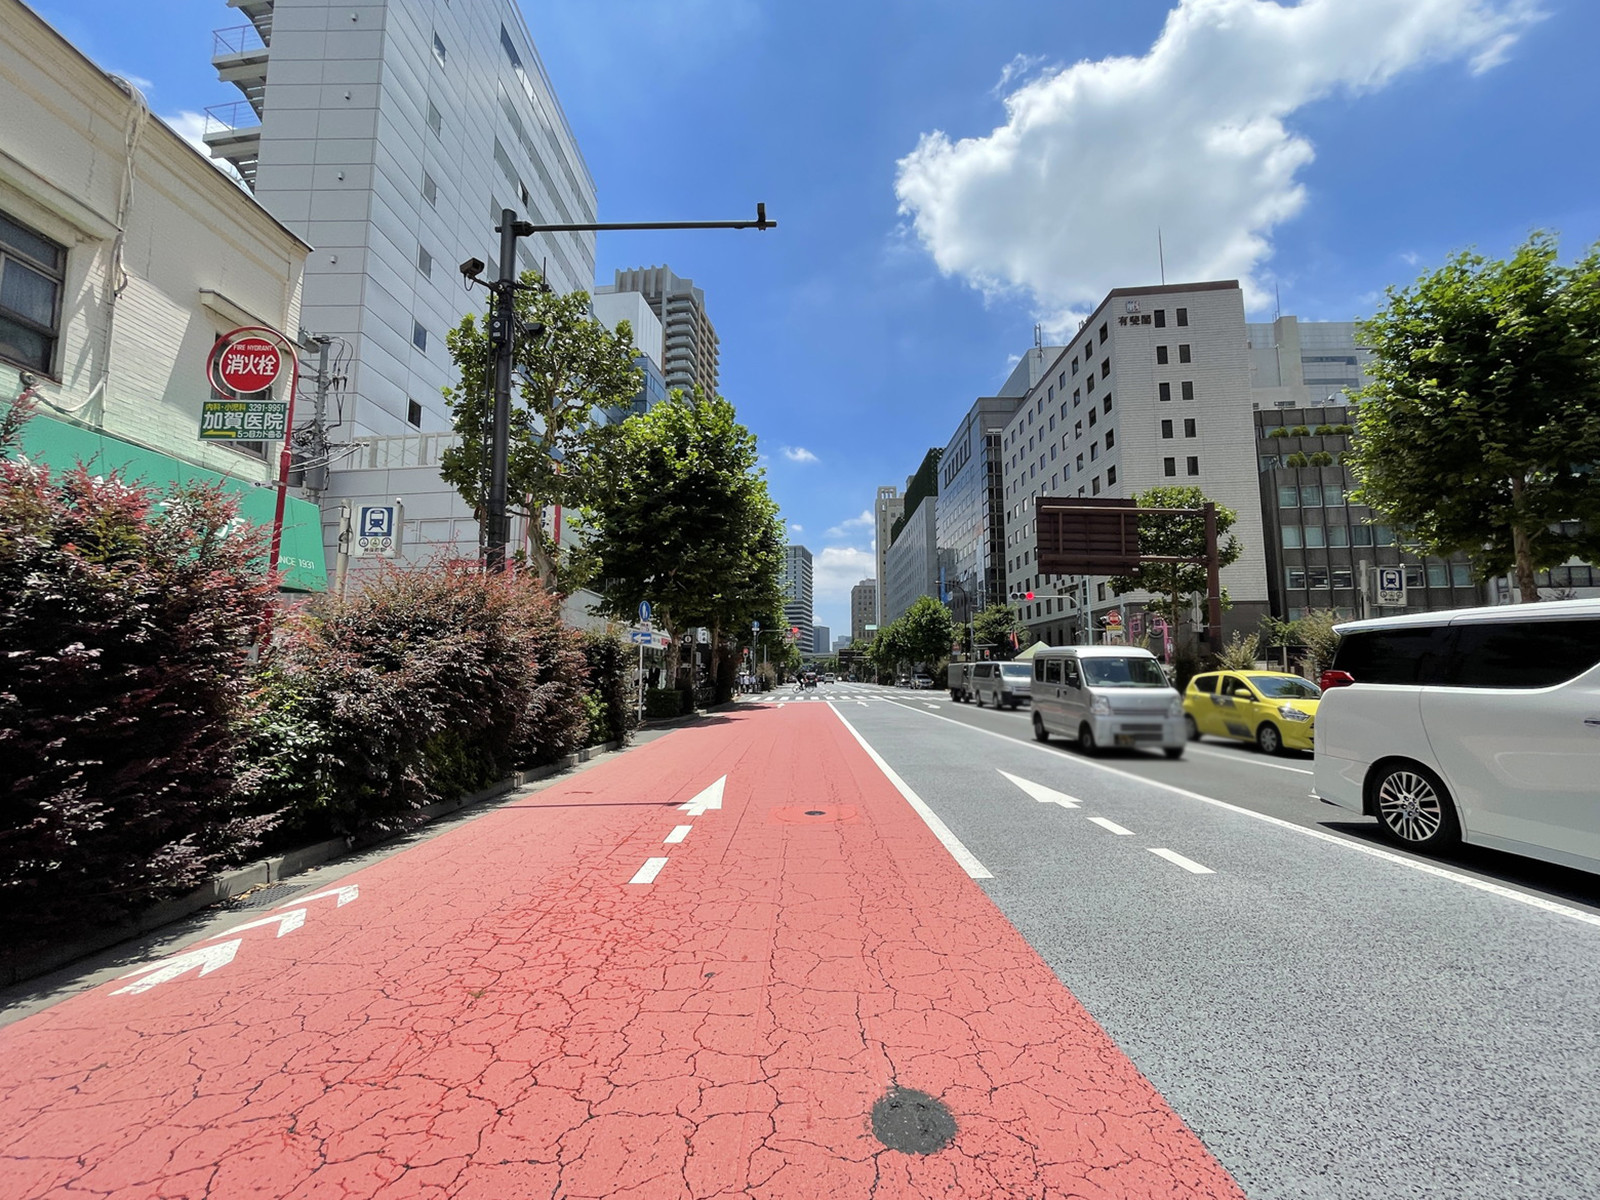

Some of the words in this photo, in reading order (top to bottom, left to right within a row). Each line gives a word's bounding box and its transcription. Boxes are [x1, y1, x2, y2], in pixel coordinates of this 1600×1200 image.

[226, 354, 277, 375] 消火栓
[203, 411, 284, 430] 加賀医院
